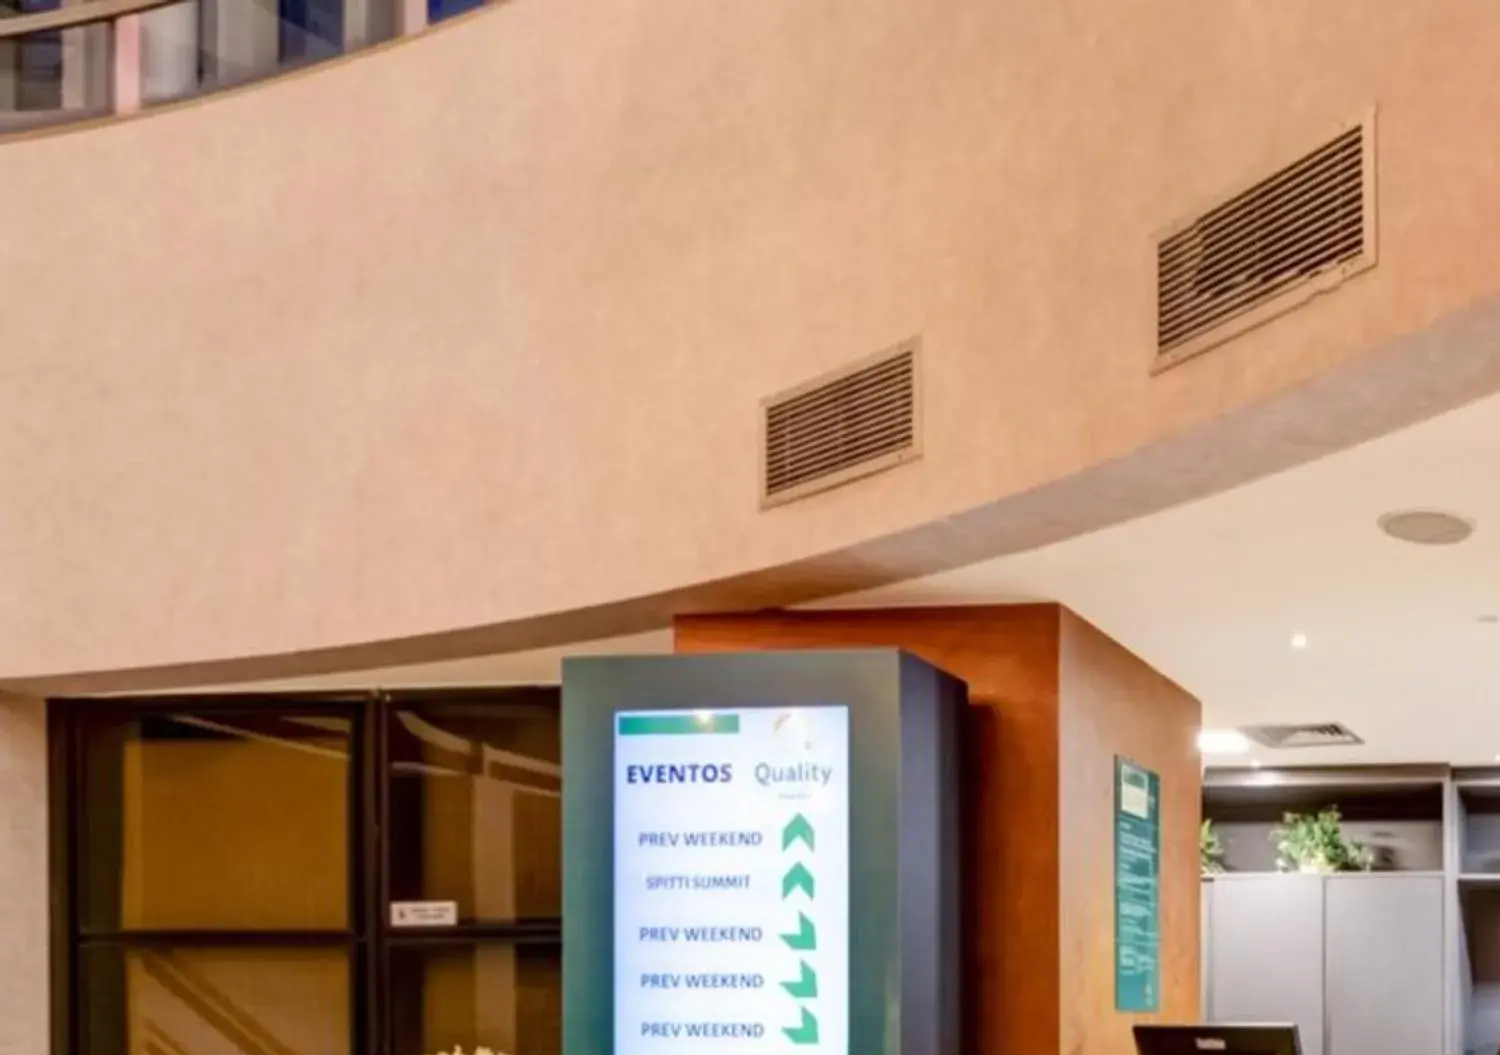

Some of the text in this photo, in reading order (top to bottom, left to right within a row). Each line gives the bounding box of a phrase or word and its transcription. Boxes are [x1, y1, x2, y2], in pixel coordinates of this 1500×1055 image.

[626, 763, 733, 784] EVENTOS
[754, 761, 832, 786] Quality
[638, 831, 763, 847] PREV WEEKEND
[639, 926, 763, 942] PREV WEEKEND
[640, 973, 765, 989] PREV WEEKEND
[640, 1021, 765, 1038] PREV WEEKEND
